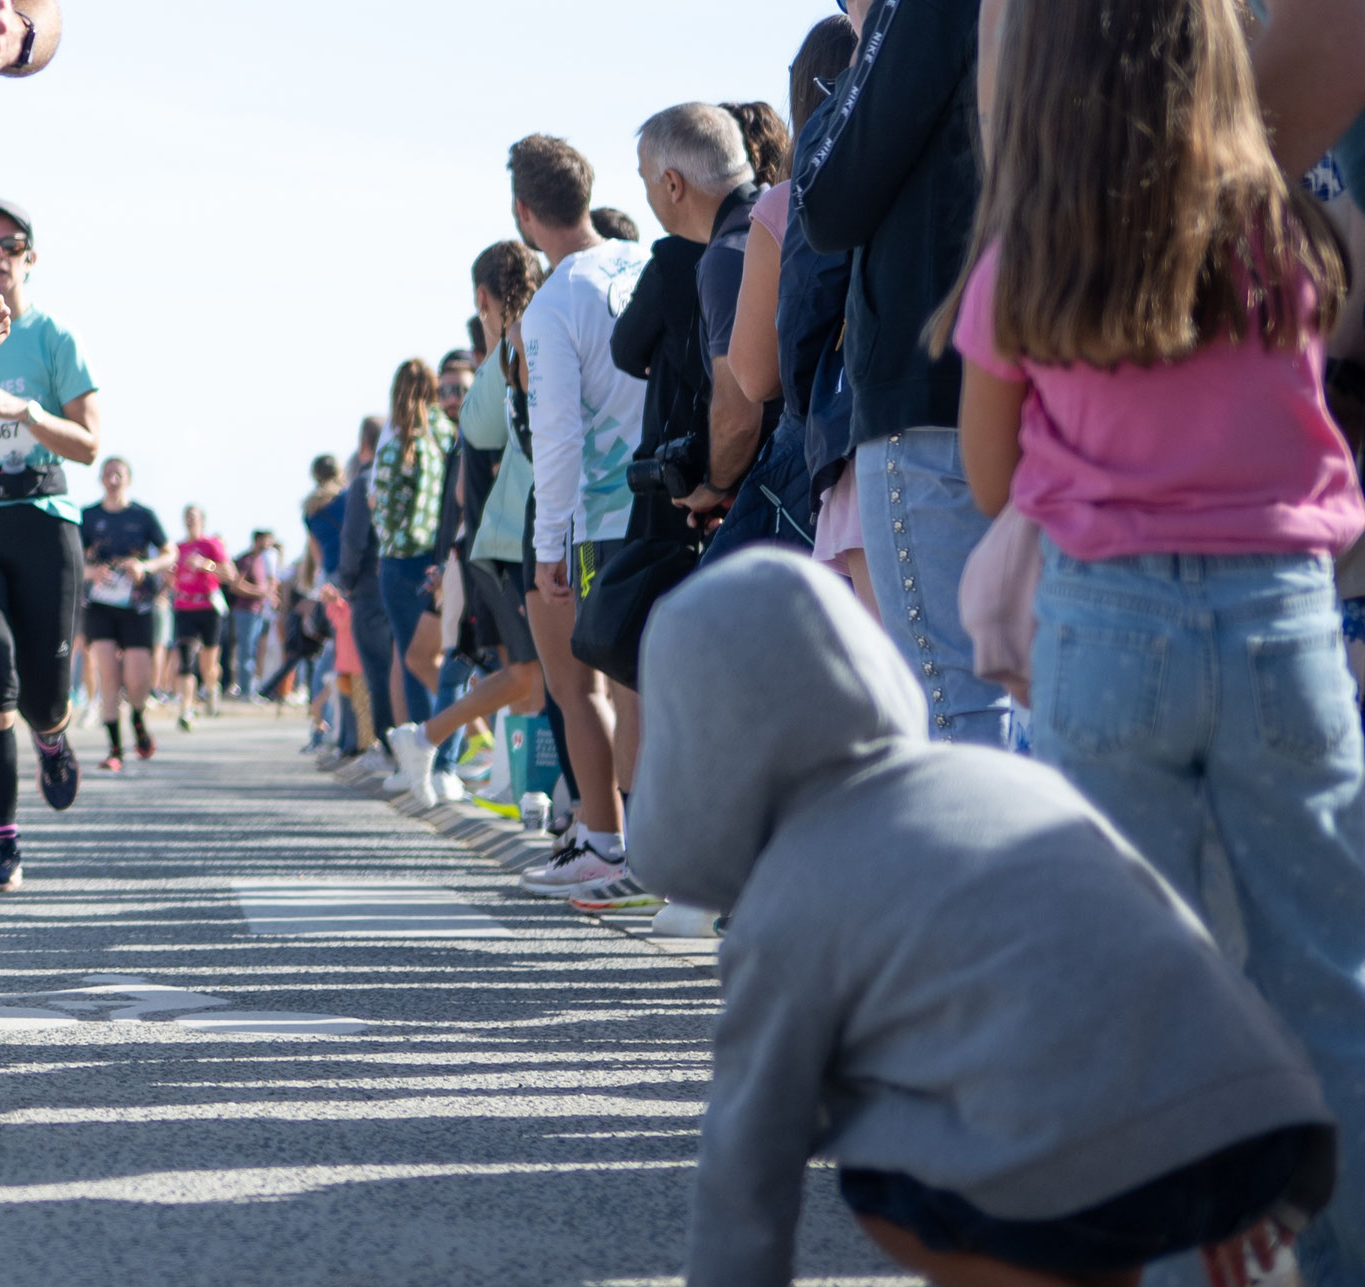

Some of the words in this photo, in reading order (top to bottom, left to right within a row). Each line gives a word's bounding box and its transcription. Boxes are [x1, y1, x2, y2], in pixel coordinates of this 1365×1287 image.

[864, 32, 883, 64] NIKE
[841, 85, 859, 117] NIKE
[811, 137, 833, 168] NIKE
